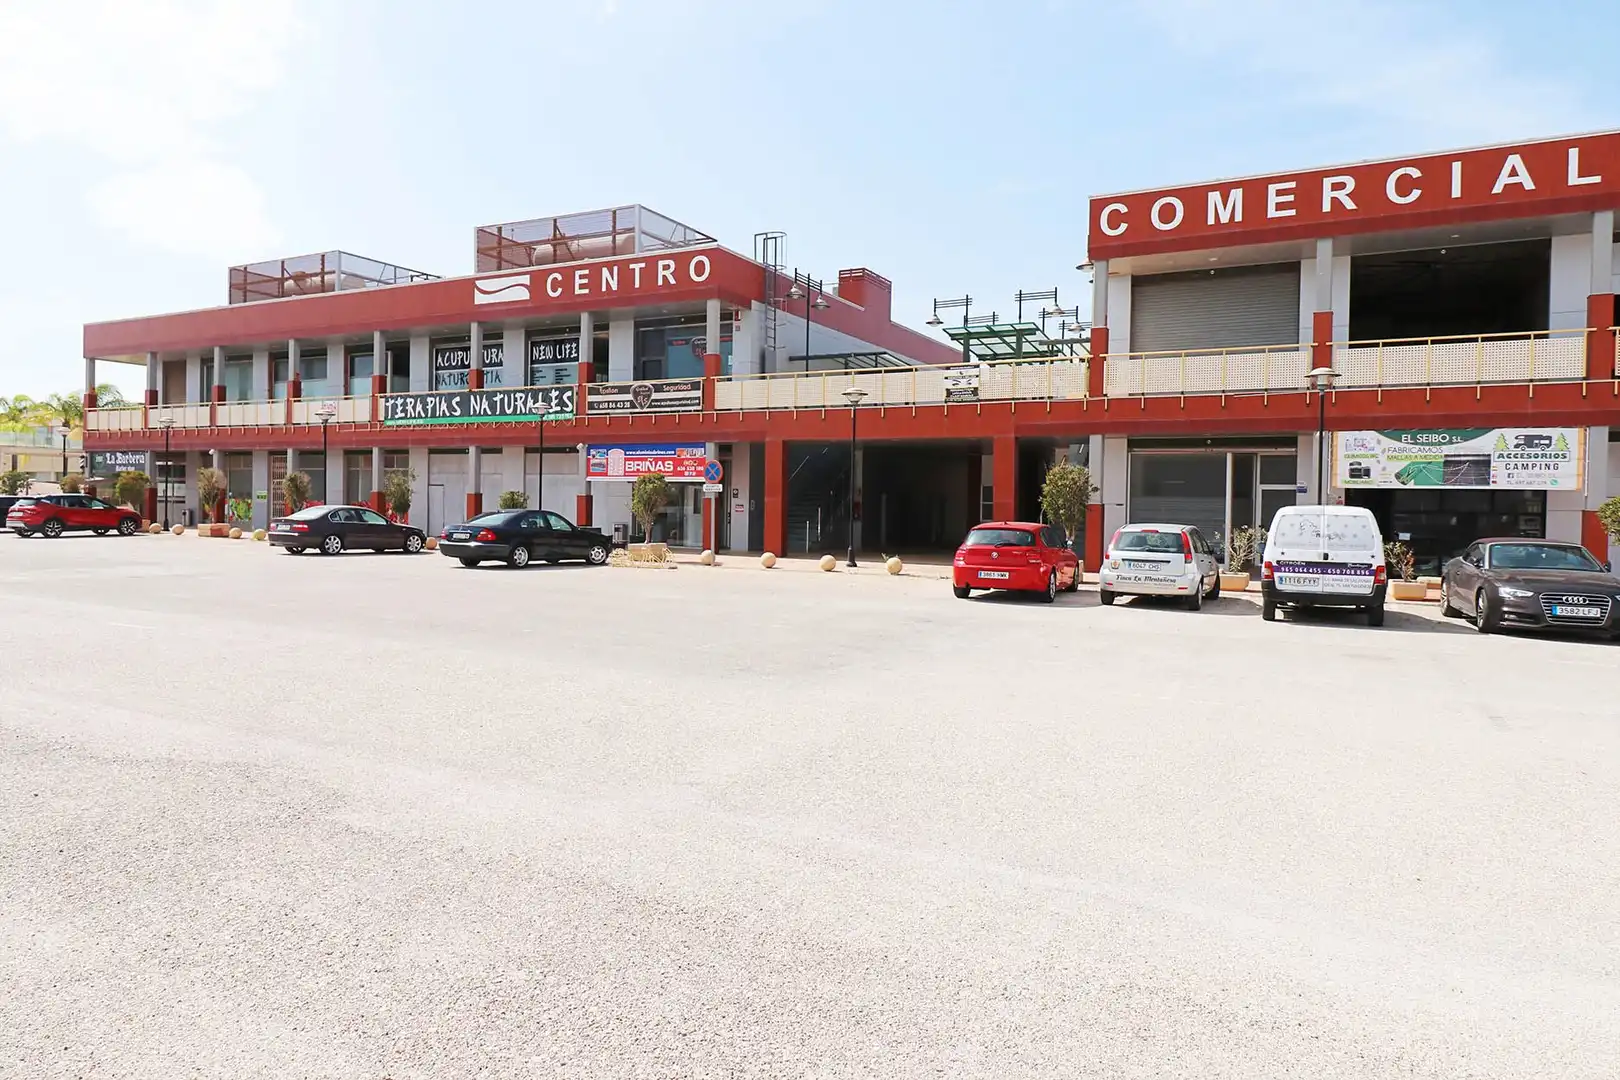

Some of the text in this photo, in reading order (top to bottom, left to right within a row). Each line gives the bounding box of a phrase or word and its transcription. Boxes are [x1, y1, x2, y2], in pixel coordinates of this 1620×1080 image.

[1100, 147, 1602, 236] COMERCIAL
[546, 255, 711, 298] CENTRO
[437, 348, 503, 367] ACUPUURA
[532, 342, 578, 360] NEW LIFE
[663, 384, 691, 392] Seguridad
[386, 389, 573, 419] TERAPIAS NATURALES
[1401, 434, 1414, 443] EL
[1416, 433, 1449, 443] SEIBO
[1387, 446, 1443, 454] FABRICAMOS
[106, 453, 115, 464] La
[625, 458, 674, 471] BRIÑAS
[1560, 607, 1599, 616] 3582 LFJ
